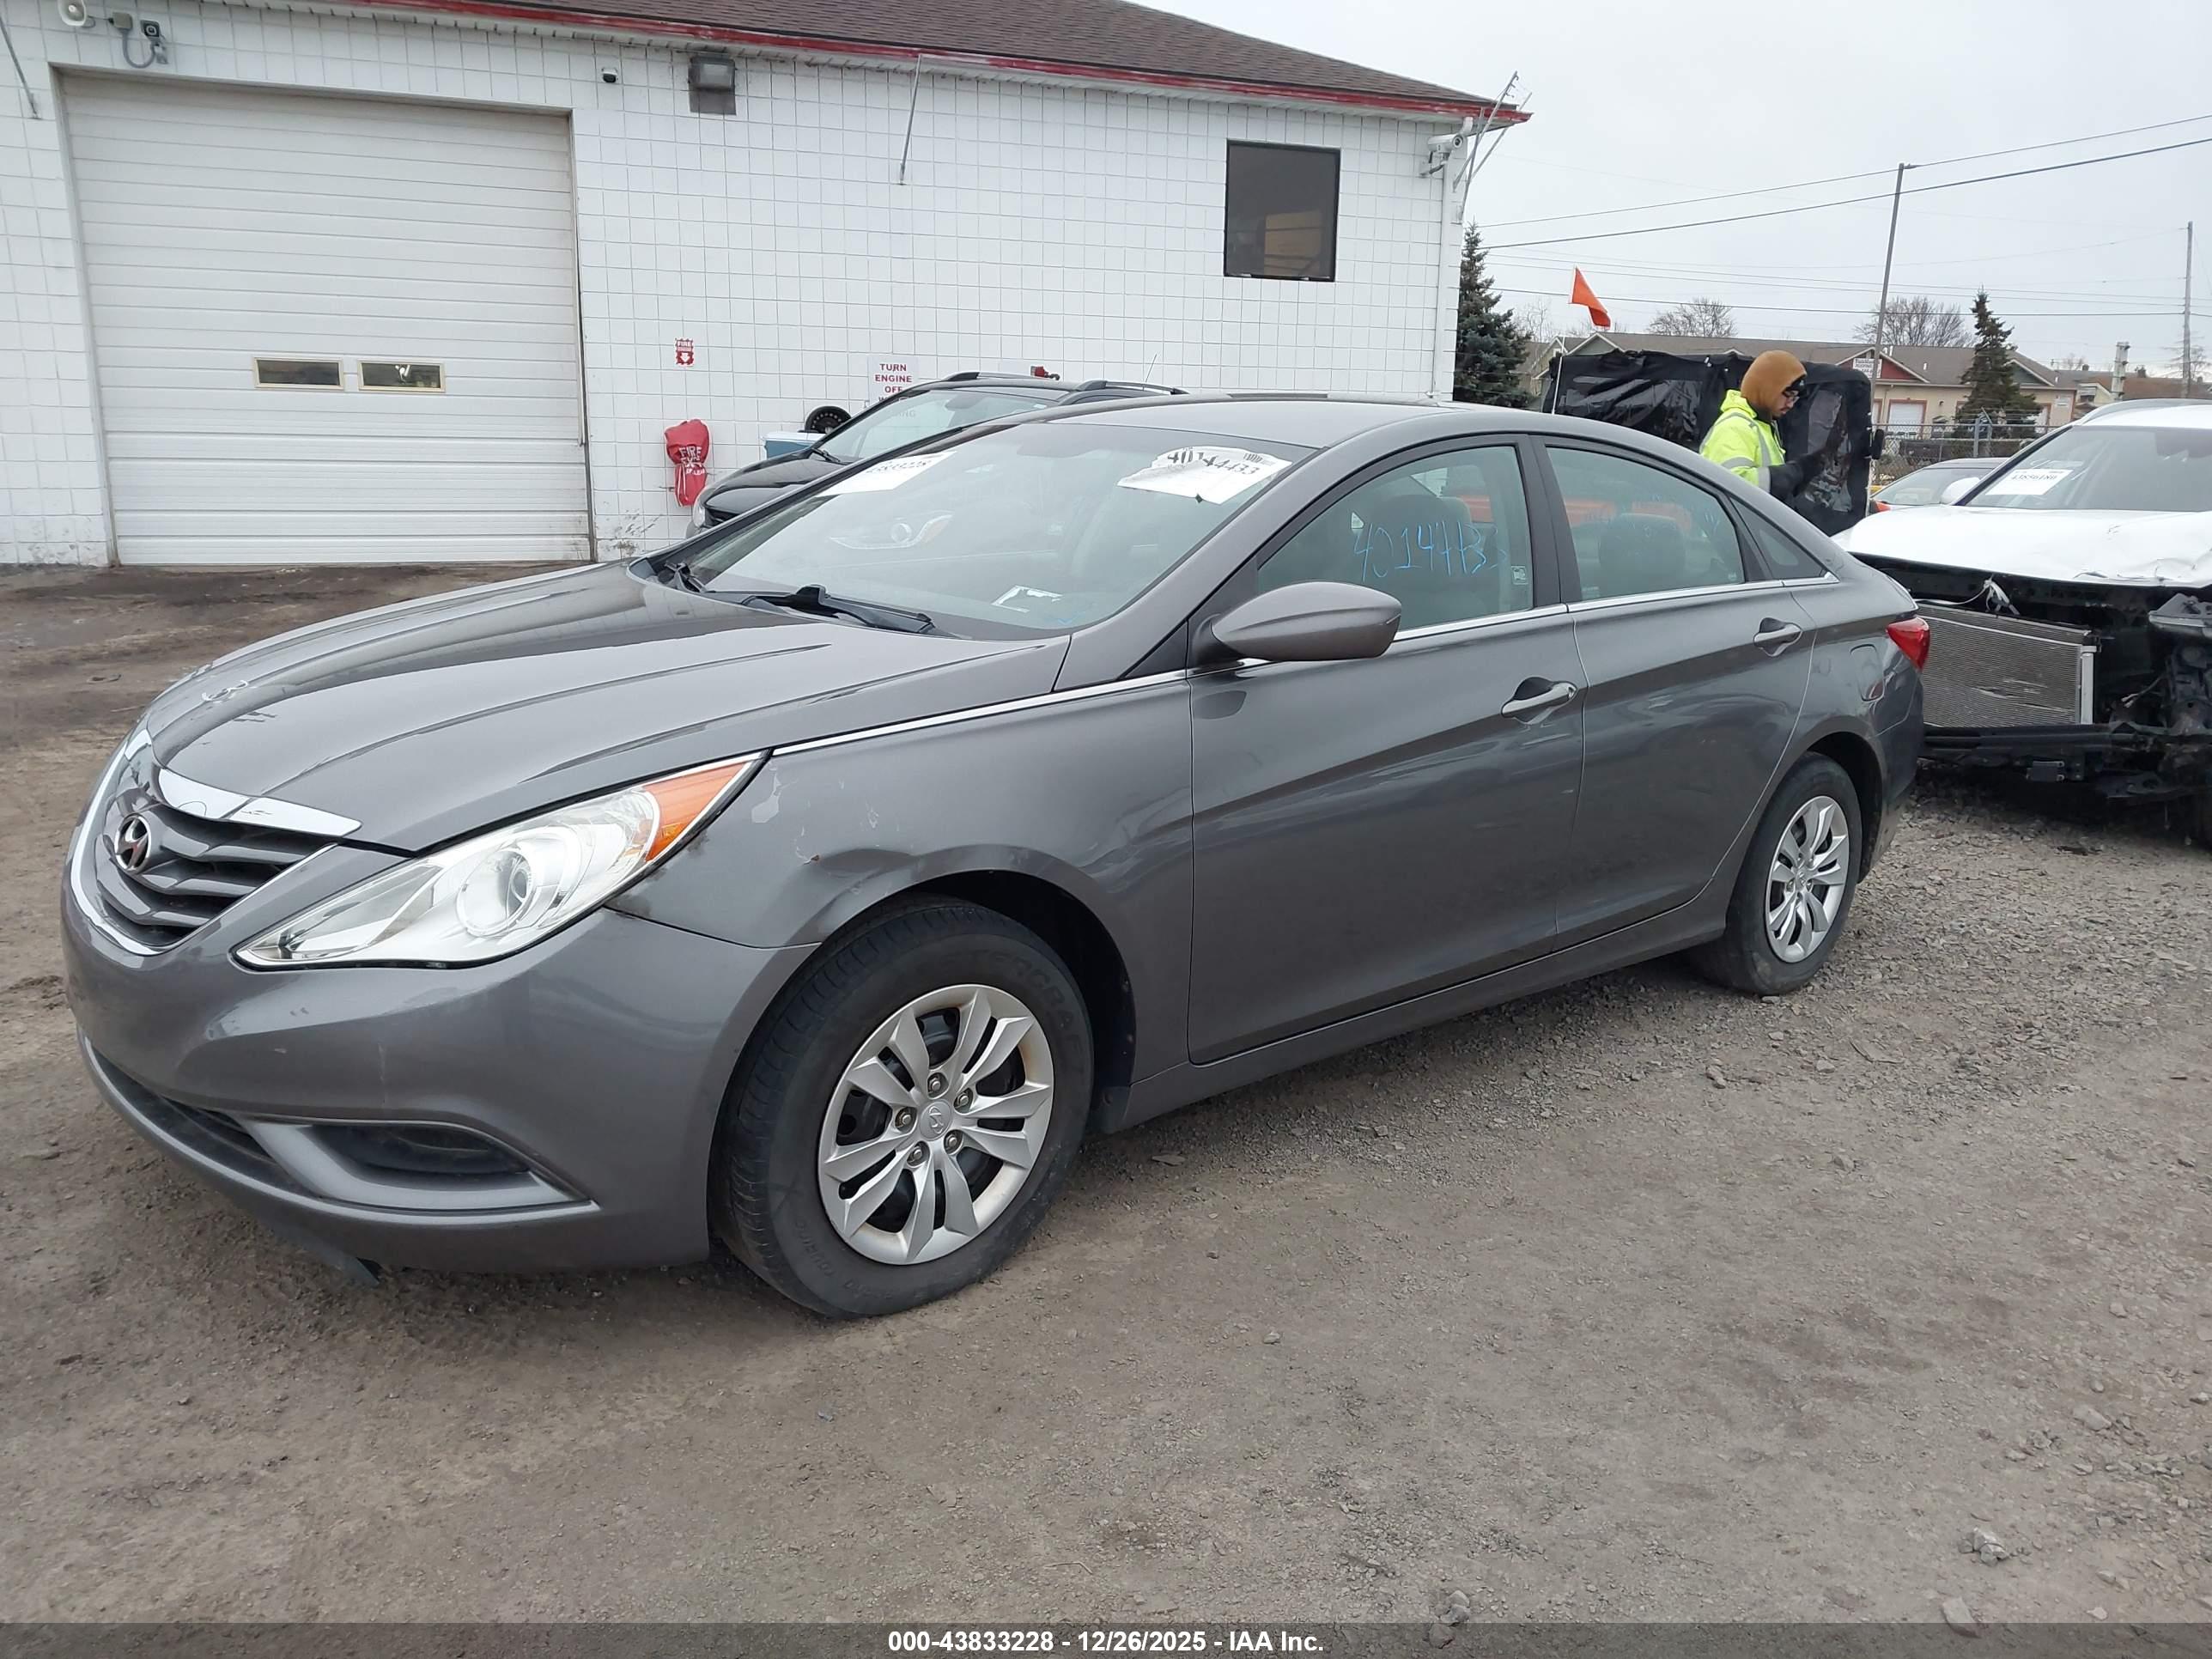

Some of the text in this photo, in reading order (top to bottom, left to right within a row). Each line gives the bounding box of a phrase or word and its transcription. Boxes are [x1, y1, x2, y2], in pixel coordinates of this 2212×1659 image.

[879, 363, 907, 372] TURN
[875, 374, 912, 383] ENGINE
[678, 446, 702, 457] FIRE
